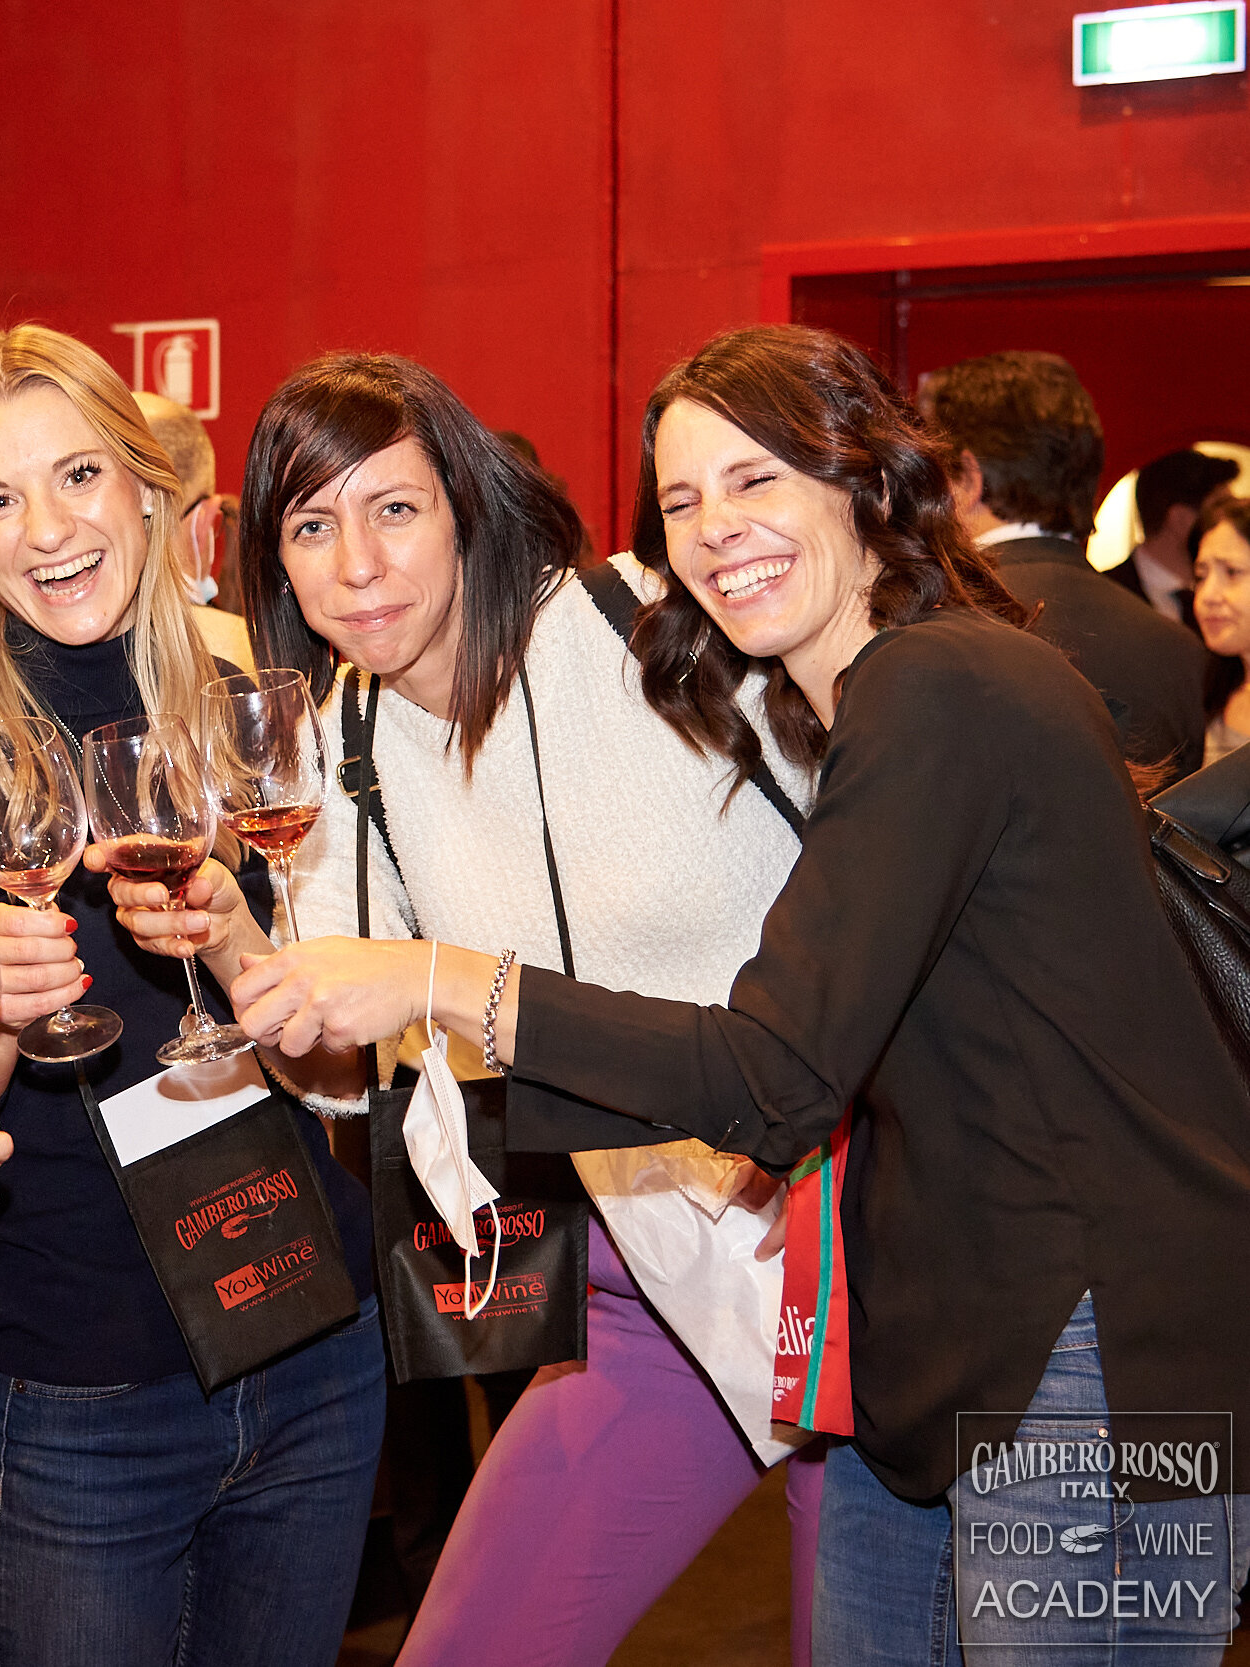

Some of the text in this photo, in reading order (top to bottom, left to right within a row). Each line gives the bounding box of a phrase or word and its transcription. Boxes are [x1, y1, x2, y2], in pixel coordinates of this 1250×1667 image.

[175, 1169, 298, 1250] GAMBERO ROSSO
[413, 1209, 545, 1251] GAMRO ROSSO
[218, 1245, 313, 1299] YouWine
[239, 1270, 313, 1312] www.youwine.it
